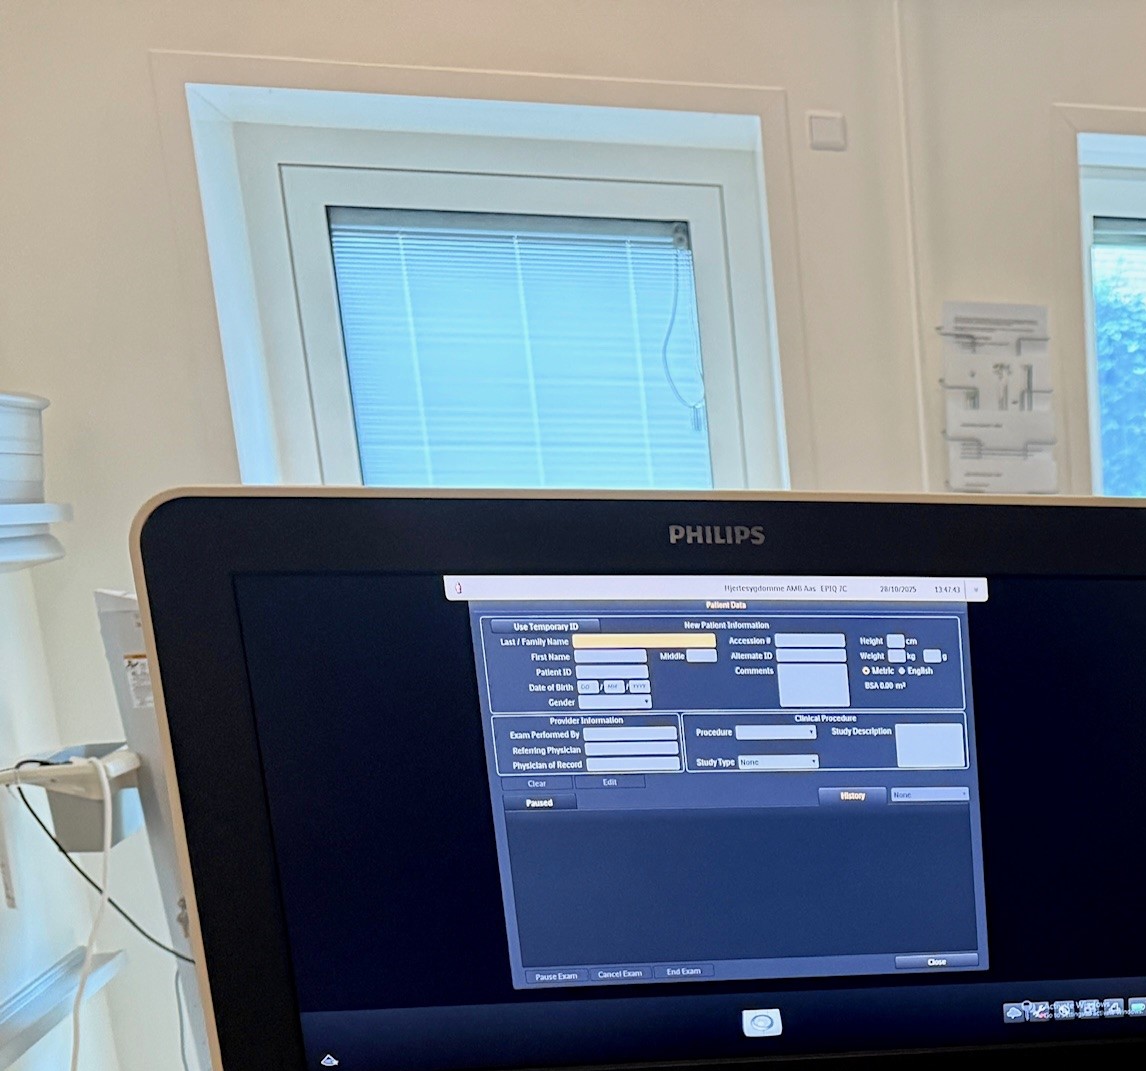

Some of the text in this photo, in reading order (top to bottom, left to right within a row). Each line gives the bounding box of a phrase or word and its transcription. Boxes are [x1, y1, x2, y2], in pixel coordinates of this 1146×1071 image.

[669, 525, 765, 545] PHILIPS
[706, 601, 747, 610] Patient Data
[513, 622, 579, 633] Use Temporary ID
[684, 621, 770, 630] New Patient Information
[500, 637, 516, 646] Last
[521, 637, 546, 648] Family
[547, 637, 569, 646] Name
[729, 637, 765, 645] Accession
[860, 637, 883, 647] Height
[531, 652, 571, 661] First Name
[660, 652, 685, 661] Middle
[731, 652, 773, 660] Alternate ID
[860, 652, 885, 662] Weight
[907, 652, 916, 662] kg
[536, 668, 572, 677] Patient ID
[735, 667, 774, 675] Comments
[872, 667, 934, 677] Metric English
[528, 683, 574, 692] Date of Birth
[864, 682, 879, 690] BSA
[548, 698, 575, 708] Gender
[550, 716, 624, 725] Provider Information
[795, 714, 857, 723] Clinical Procedure
[510, 731, 580, 741] Exam Performed By
[696, 728, 732, 737] Procedure
[831, 727, 892, 736] Study Description
[512, 745, 581, 756] Referring Physician
[513, 760, 583, 770] Physician of Record
[696, 758, 735, 768] Study Type
[740, 758, 759, 766] None
[527, 779, 546, 787] Clear
[603, 778, 617, 786] Edit
[840, 791, 866, 801] History
[894, 791, 912, 799] None
[526, 798, 553, 808] Paused
[928, 958, 946, 966] Close
[598, 969, 642, 979] Cancel Exam
[667, 967, 701, 976] End Exam
[535, 972, 578, 981] Pause Exam
